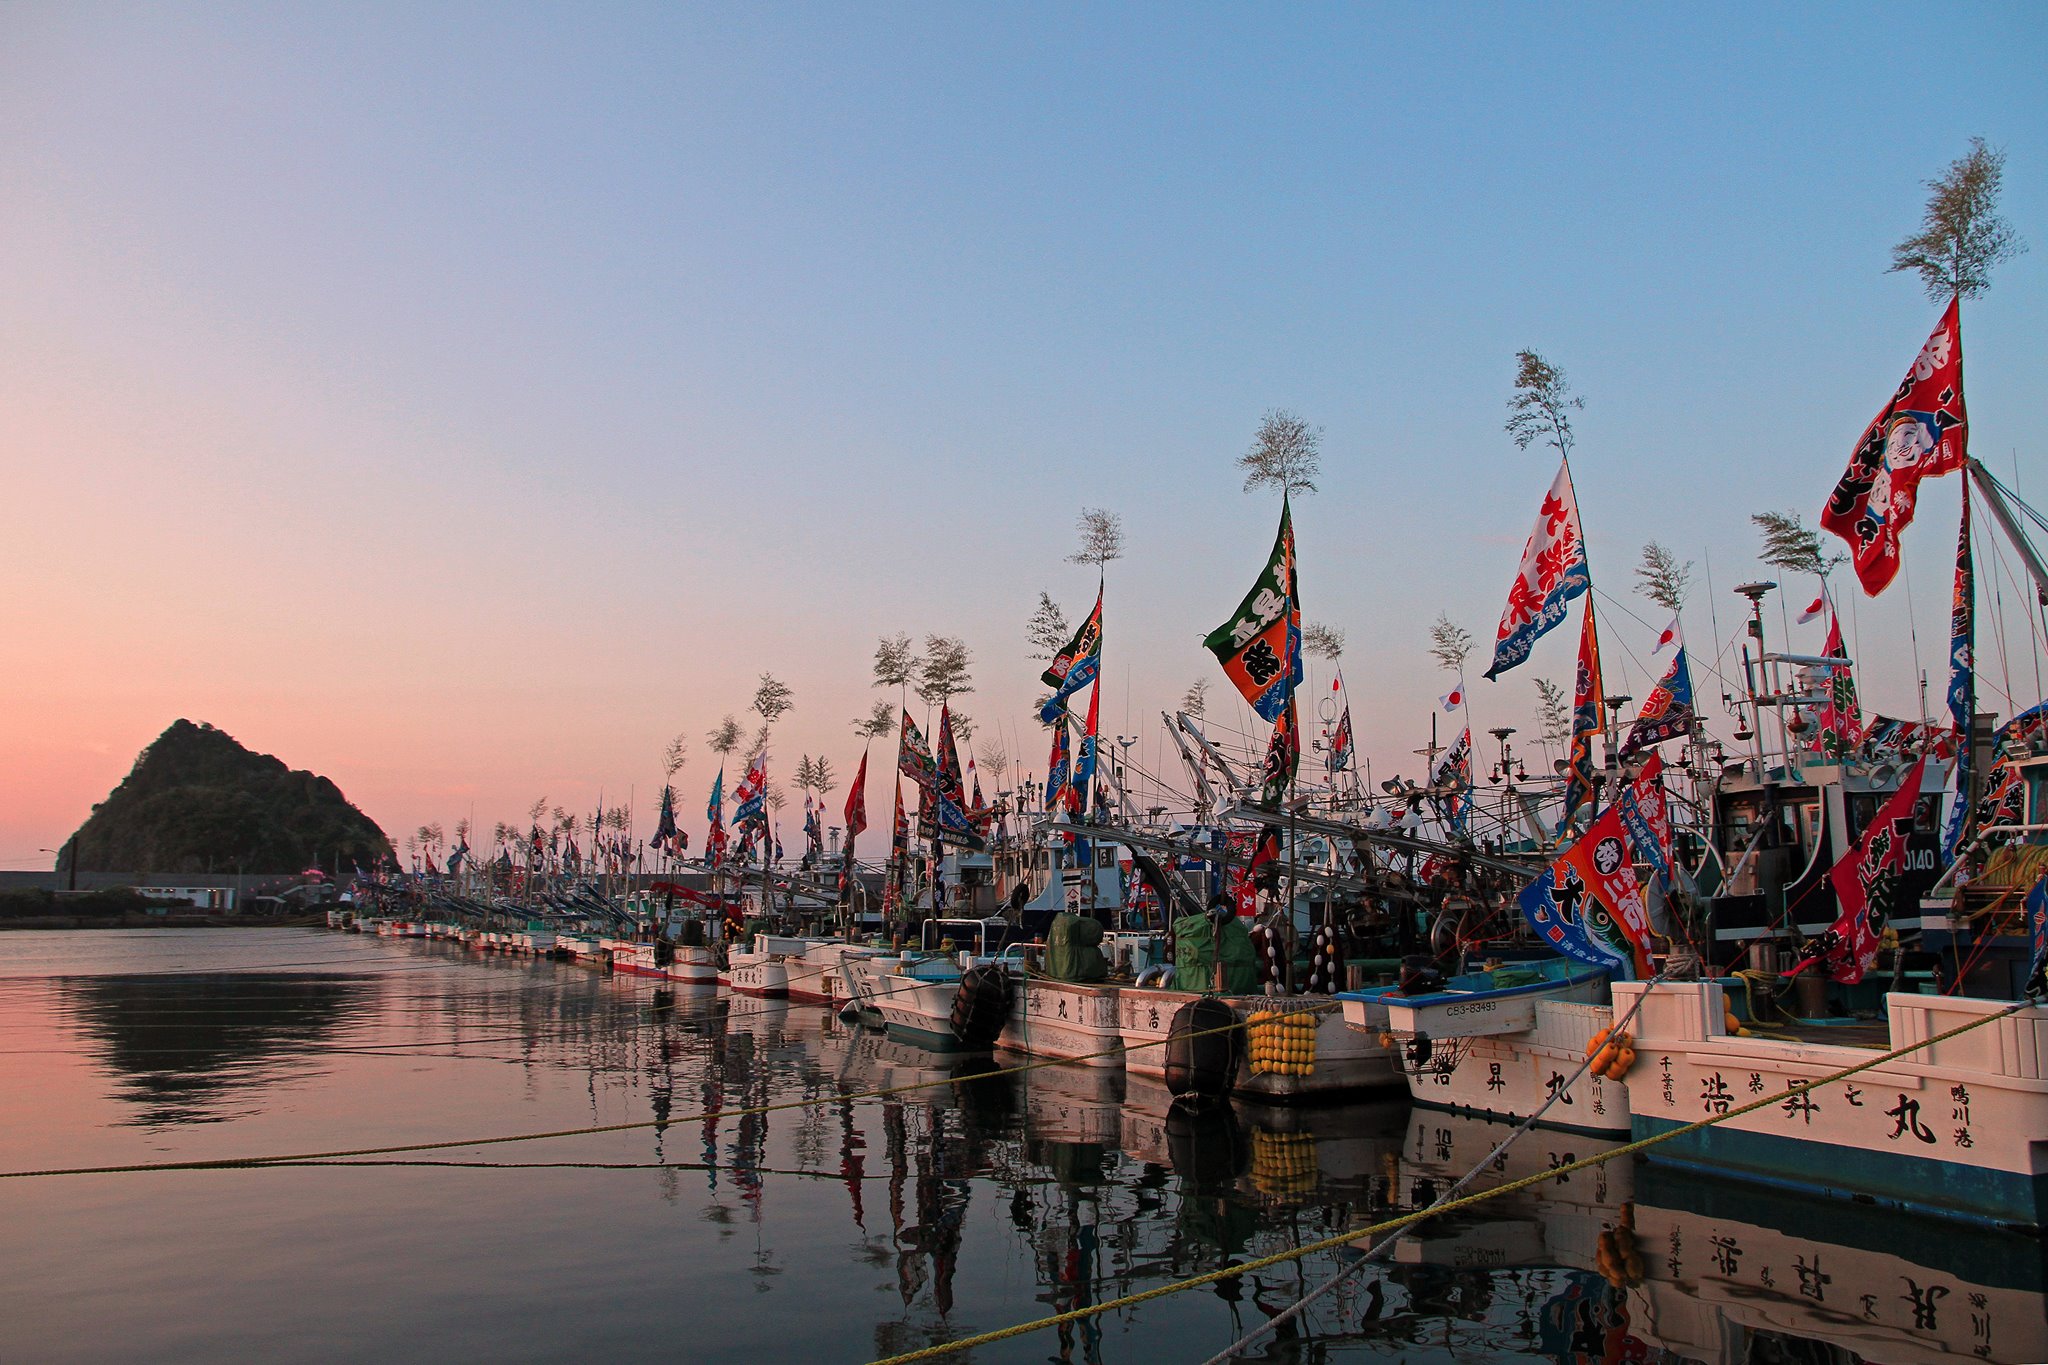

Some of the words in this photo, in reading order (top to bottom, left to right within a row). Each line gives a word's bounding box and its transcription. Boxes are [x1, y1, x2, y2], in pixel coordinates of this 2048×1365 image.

[1446, 1001, 1497, 1017] CB3-83493
[1951, 1084, 1974, 1148] 鴨川港
